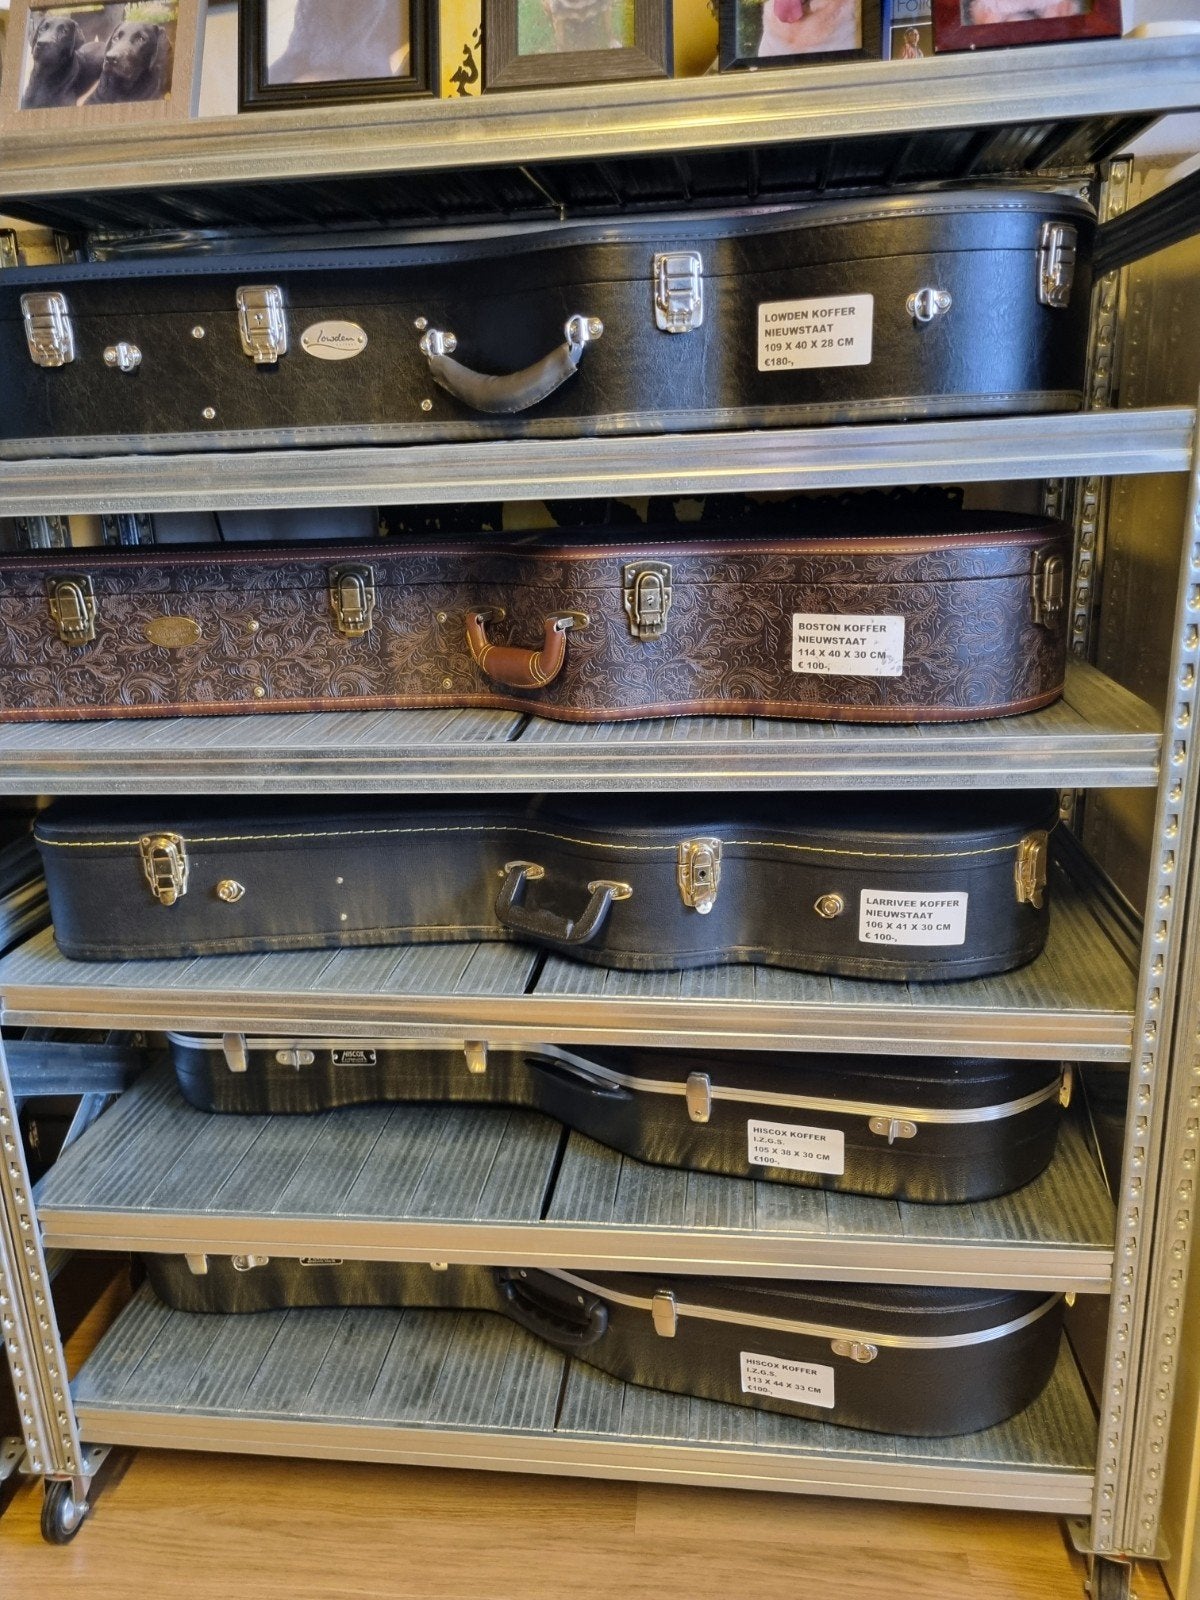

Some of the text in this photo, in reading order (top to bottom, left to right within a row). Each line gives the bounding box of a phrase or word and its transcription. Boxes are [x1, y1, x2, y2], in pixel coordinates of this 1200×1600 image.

[764, 307, 855, 322] LOWDEN KOFFER
[764, 324, 833, 337] NIEUWSTAAT
[765, 337, 854, 352] 109 X 40 X 28 CM
[798, 622, 887, 633] BOSTON KOFFER
[798, 635, 867, 646] NIEUWSTAAT
[819, 649, 826, 658] X
[828, 650, 841, 658] 40
[844, 650, 851, 659] X
[854, 651, 867, 659] 30
[870, 651, 887, 659] CM
[866, 898, 960, 908] LARRIVEE KOFFER
[866, 909, 934, 919] NIEUWSTAAT
[866, 921, 883, 929] 106
[886, 922, 893, 930] X
[896, 923, 907, 931] 41
[753, 1126, 827, 1142] HISCOX KOFFER
[753, 1136, 786, 1146] I.Z.G.S.
[754, 1145, 770, 1153] 105
[772, 1147, 778, 1155] X
[816, 1153, 831, 1161] CM
[746, 1358, 818, 1376] HISCOX KOFFER
[747, 1376, 763, 1384] 113
[807, 1386, 822, 1394] CM
